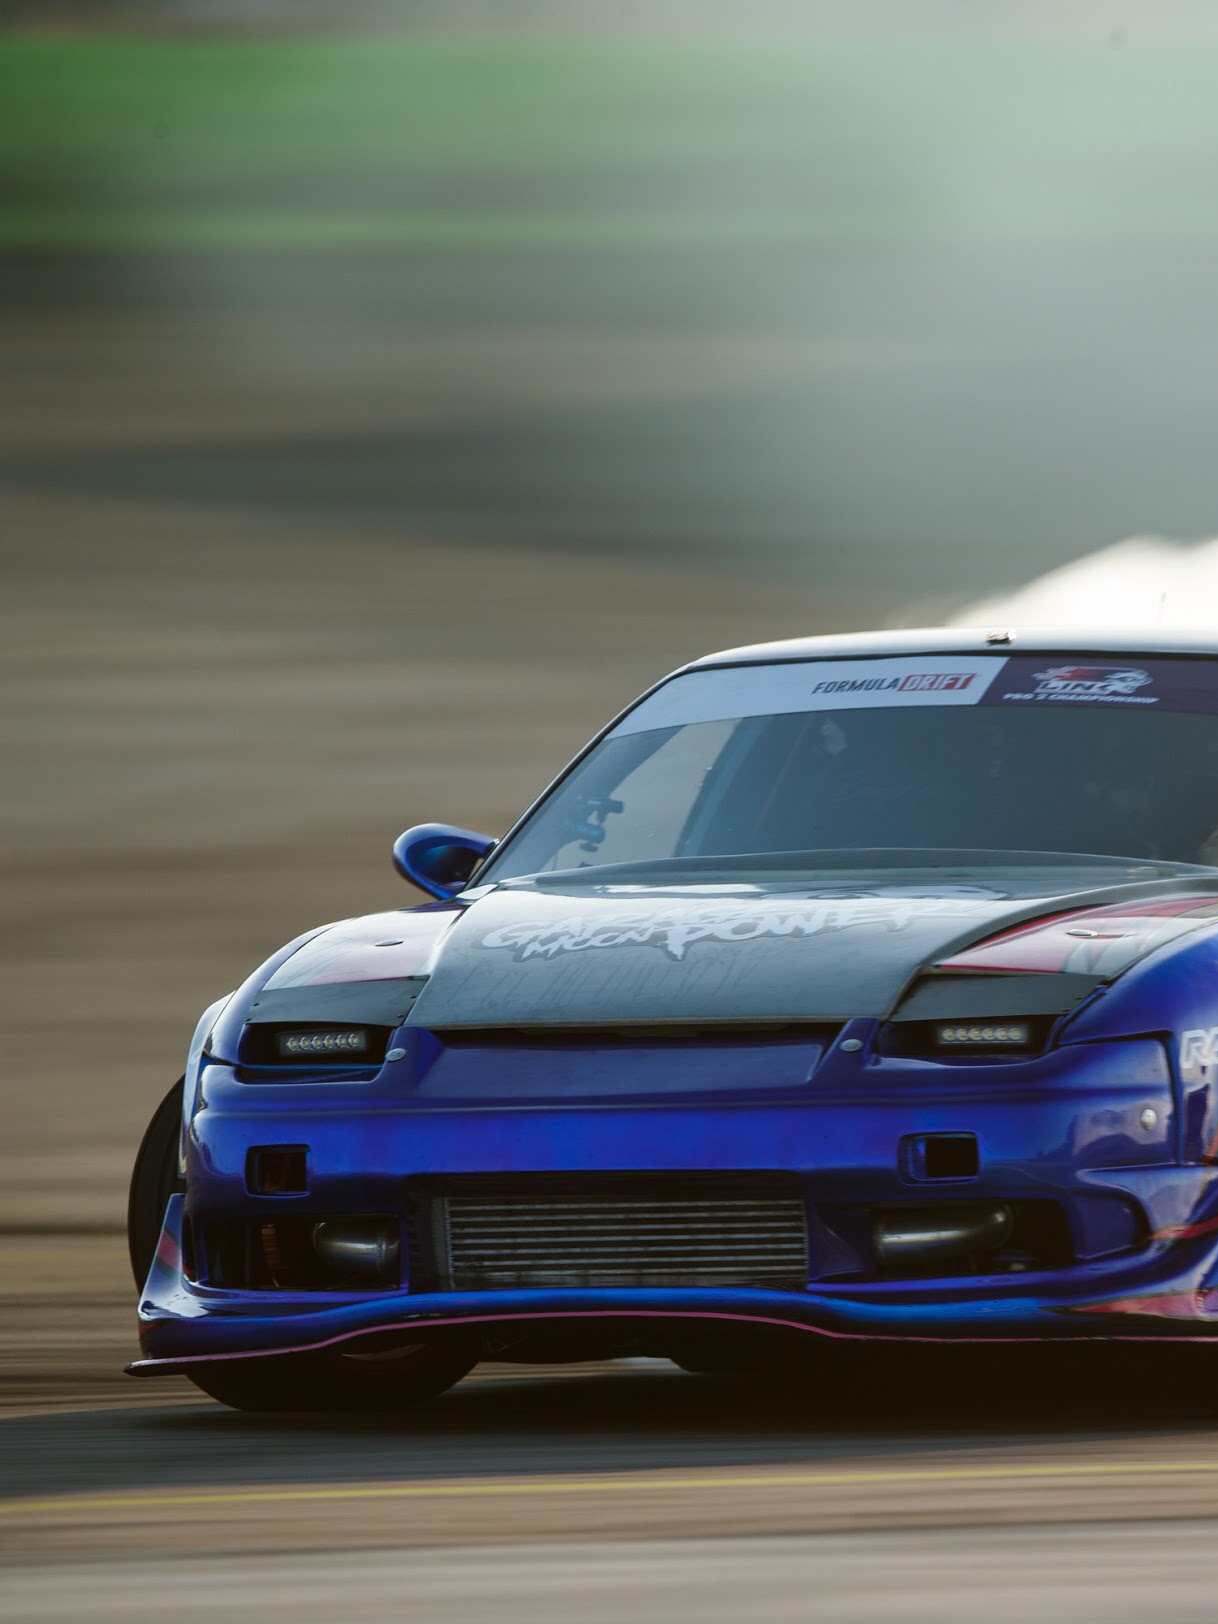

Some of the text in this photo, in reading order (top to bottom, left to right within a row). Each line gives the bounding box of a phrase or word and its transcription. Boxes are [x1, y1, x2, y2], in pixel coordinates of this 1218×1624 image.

[811, 673, 978, 694] FORMULA DRIFT
[1036, 681, 1113, 694] LINK
